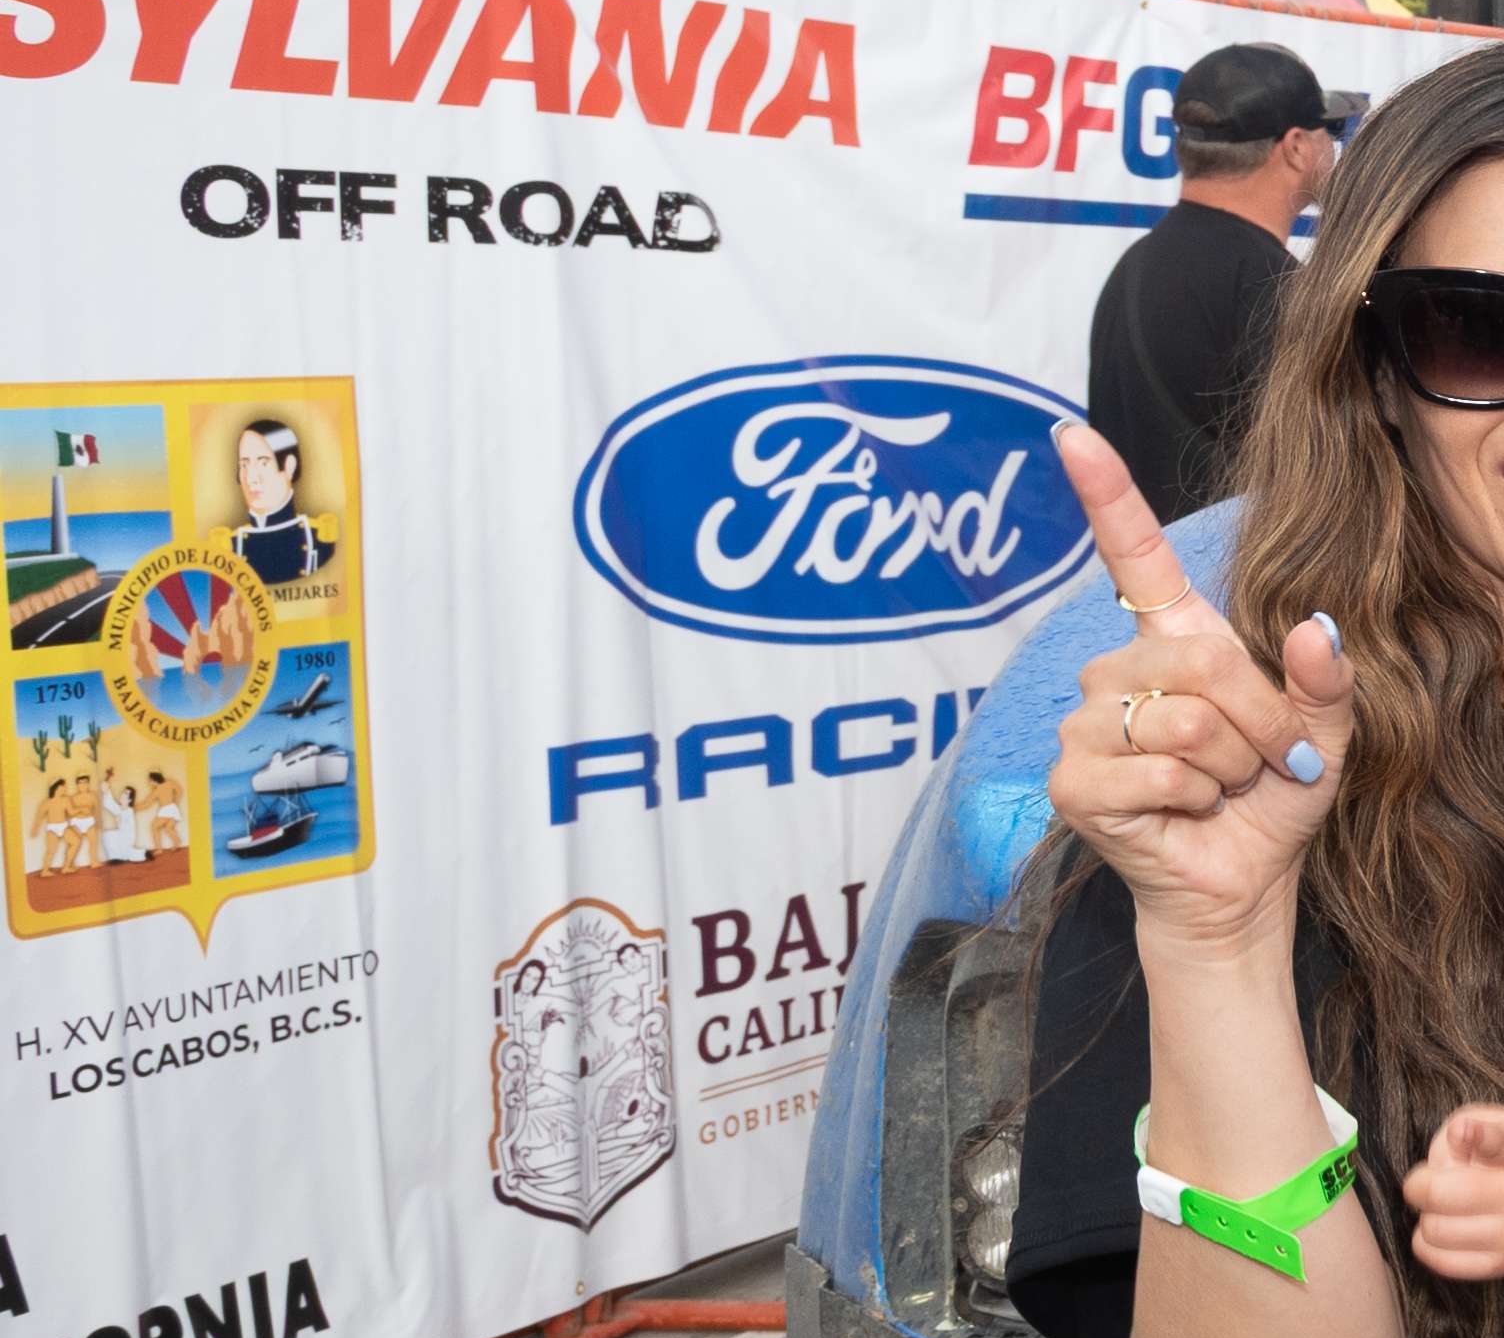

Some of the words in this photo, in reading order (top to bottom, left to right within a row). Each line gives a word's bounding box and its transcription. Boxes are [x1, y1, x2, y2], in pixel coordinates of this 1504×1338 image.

[967, 44, 1182, 181] BFG
[180, 163, 397, 243] OFF
[425, 174, 723, 256] ROAD
[697, 404, 1029, 591] Ford
[108, 552, 172, 652] MUNICIPIO
[174, 547, 200, 566] DE
[201, 549, 238, 580] LOS
[234, 570, 273, 634] CABOS
[34, 680, 87, 705] 1730
[112, 674, 147, 726] BAJA
[147, 697, 255, 744] CALIFORNIA
[248, 657, 272, 701] SUR
[294, 650, 337, 672] 1980
[691, 881, 867, 998] BAJ
[15, 1029, 53, 1061] H.
[61, 1010, 115, 1051] XV
[121, 949, 380, 1037] AYUNTAMIENTO
[48, 1056, 126, 1102] LOS
[130, 1022, 261, 1080] CABOS,
[268, 999, 364, 1045] B.C.S.
